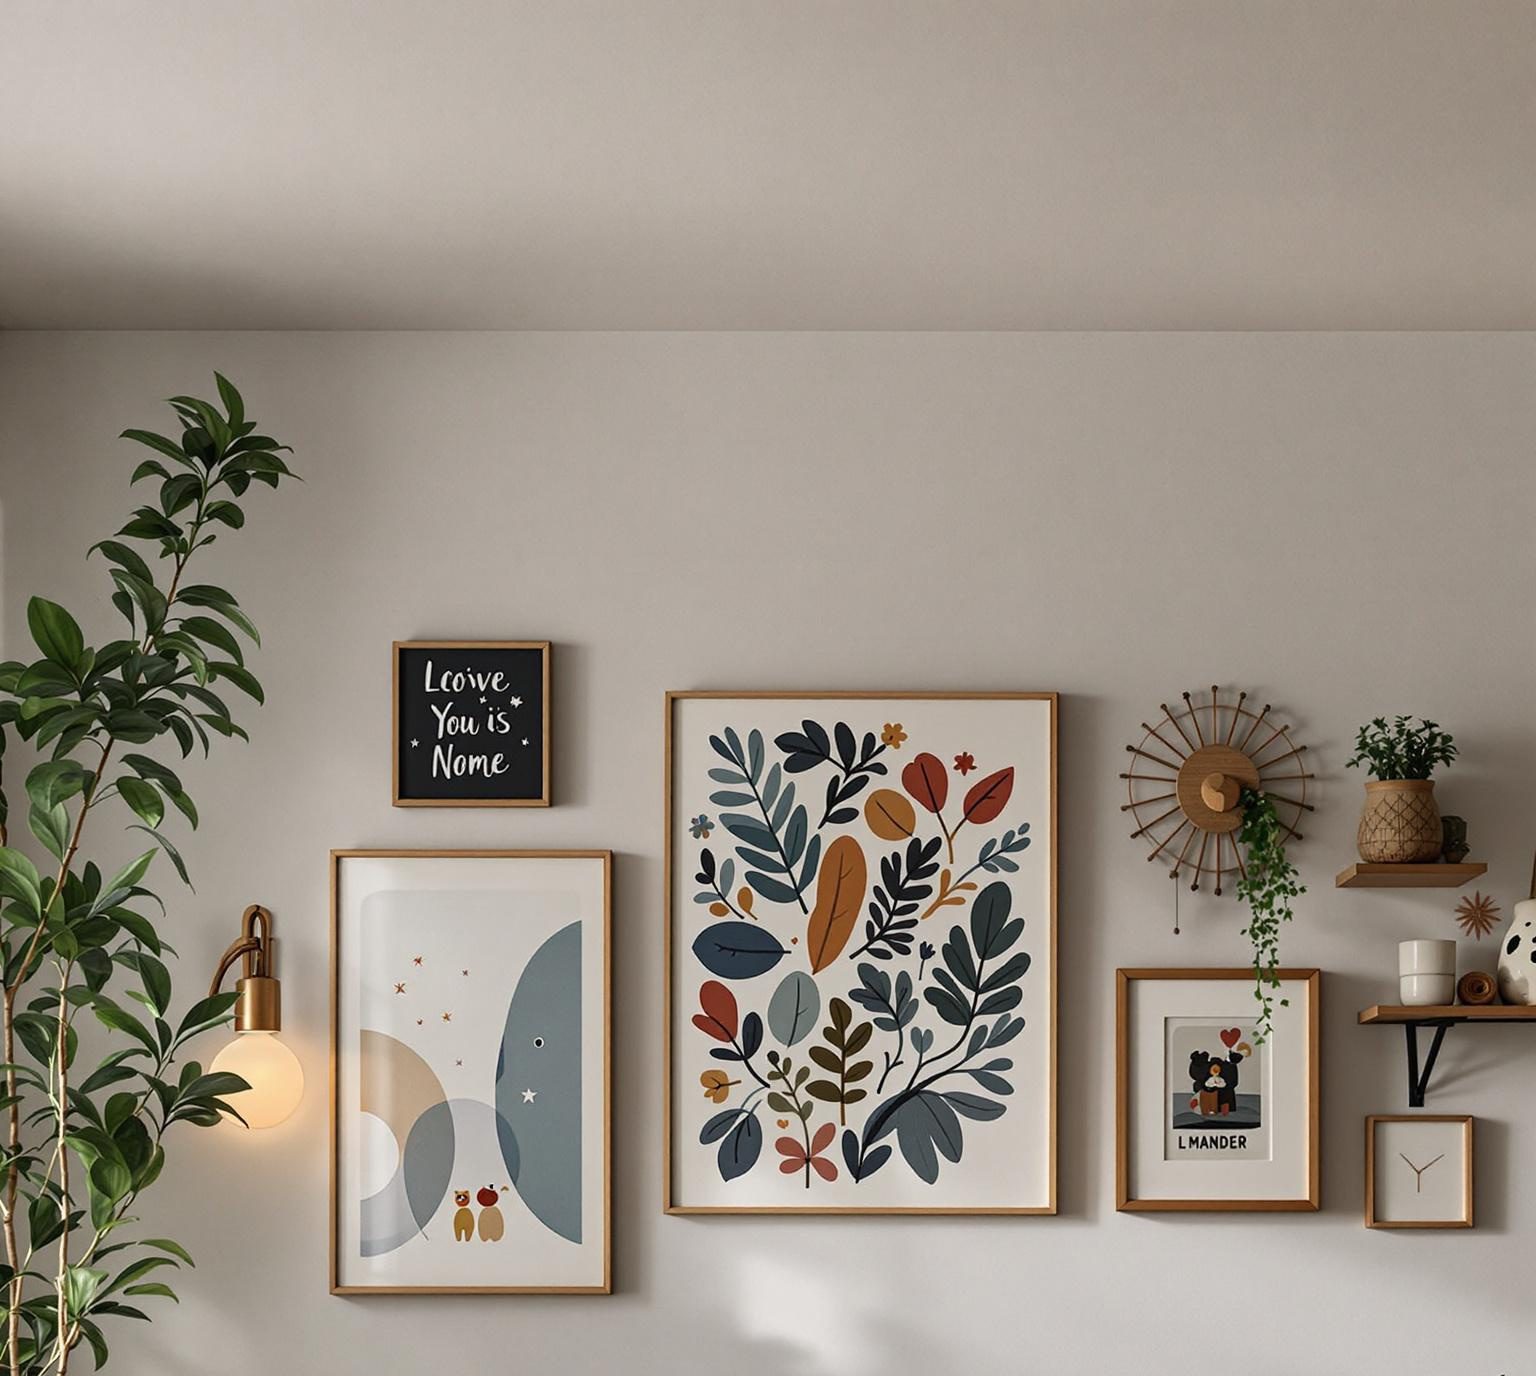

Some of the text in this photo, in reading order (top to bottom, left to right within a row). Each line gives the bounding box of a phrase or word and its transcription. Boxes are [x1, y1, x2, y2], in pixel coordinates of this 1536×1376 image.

[430, 702, 511, 740] You is
[432, 743, 510, 780] Nome
[1178, 1135, 1247, 1149] L MANDER
